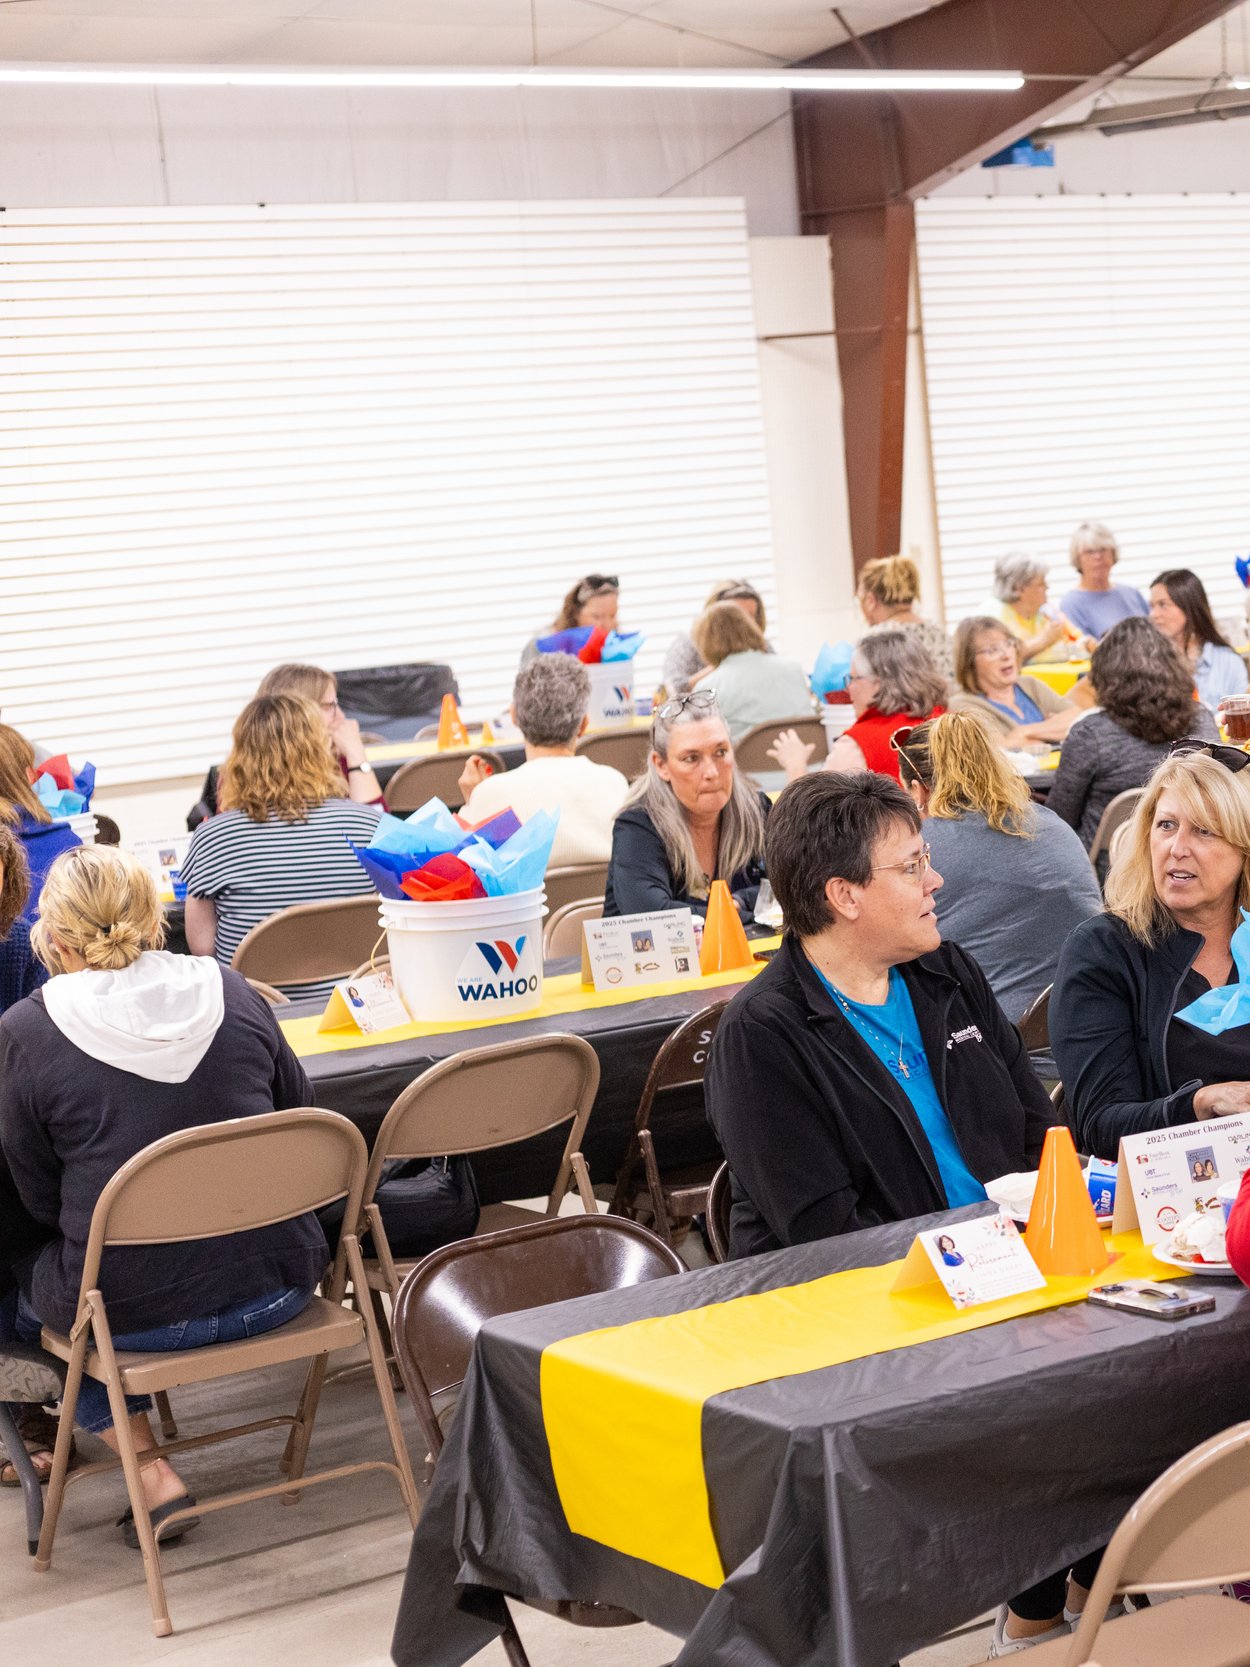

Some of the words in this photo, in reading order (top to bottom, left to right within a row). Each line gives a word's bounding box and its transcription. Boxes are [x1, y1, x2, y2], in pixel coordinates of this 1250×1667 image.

[457, 975, 538, 1002] WAHOO
[1145, 1134, 1167, 1145] 2025
[1168, 1129, 1201, 1141] Chamber
[1202, 1120, 1243, 1133] Champions
[1151, 1182, 1178, 1193] Saunders
